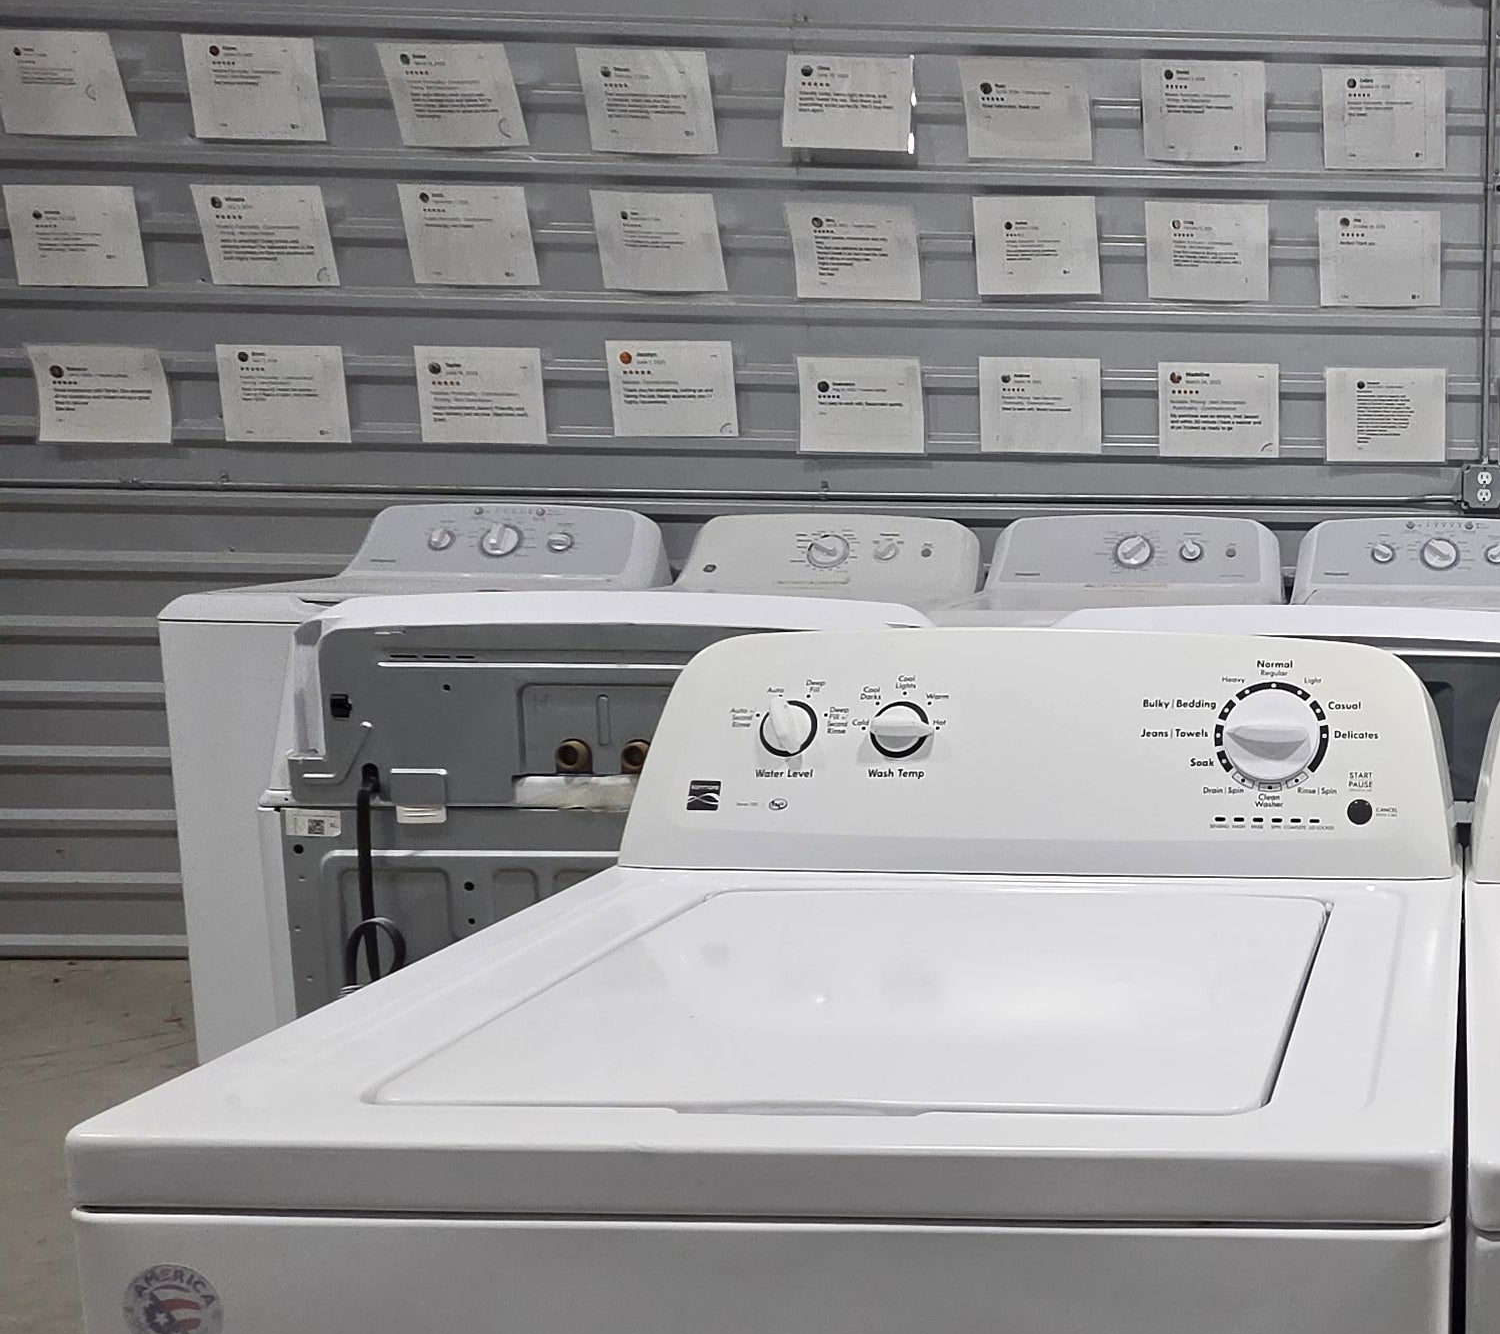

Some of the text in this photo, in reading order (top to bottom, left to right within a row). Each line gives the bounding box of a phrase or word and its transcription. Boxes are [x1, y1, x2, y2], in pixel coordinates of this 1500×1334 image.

[1256, 660, 1293, 669] Normal
[806, 679, 826, 687] Deep
[1304, 677, 1322, 685] Light
[1143, 699, 1216, 710] Bulky Bedding
[1328, 701, 1362, 711] Casual
[830, 707, 850, 715] Deep
[852, 719, 870, 727] Cold
[1140, 729, 1208, 737] Jeans Towels
[1334, 731, 1379, 739] Delicates
[1190, 759, 1214, 767] Soak
[756, 769, 814, 778] Water Level
[868, 769, 925, 780] Wash Temp
[1228, 787, 1244, 795] Spin
[1322, 788, 1337, 796] Spin
[1258, 793, 1280, 801] Clean
